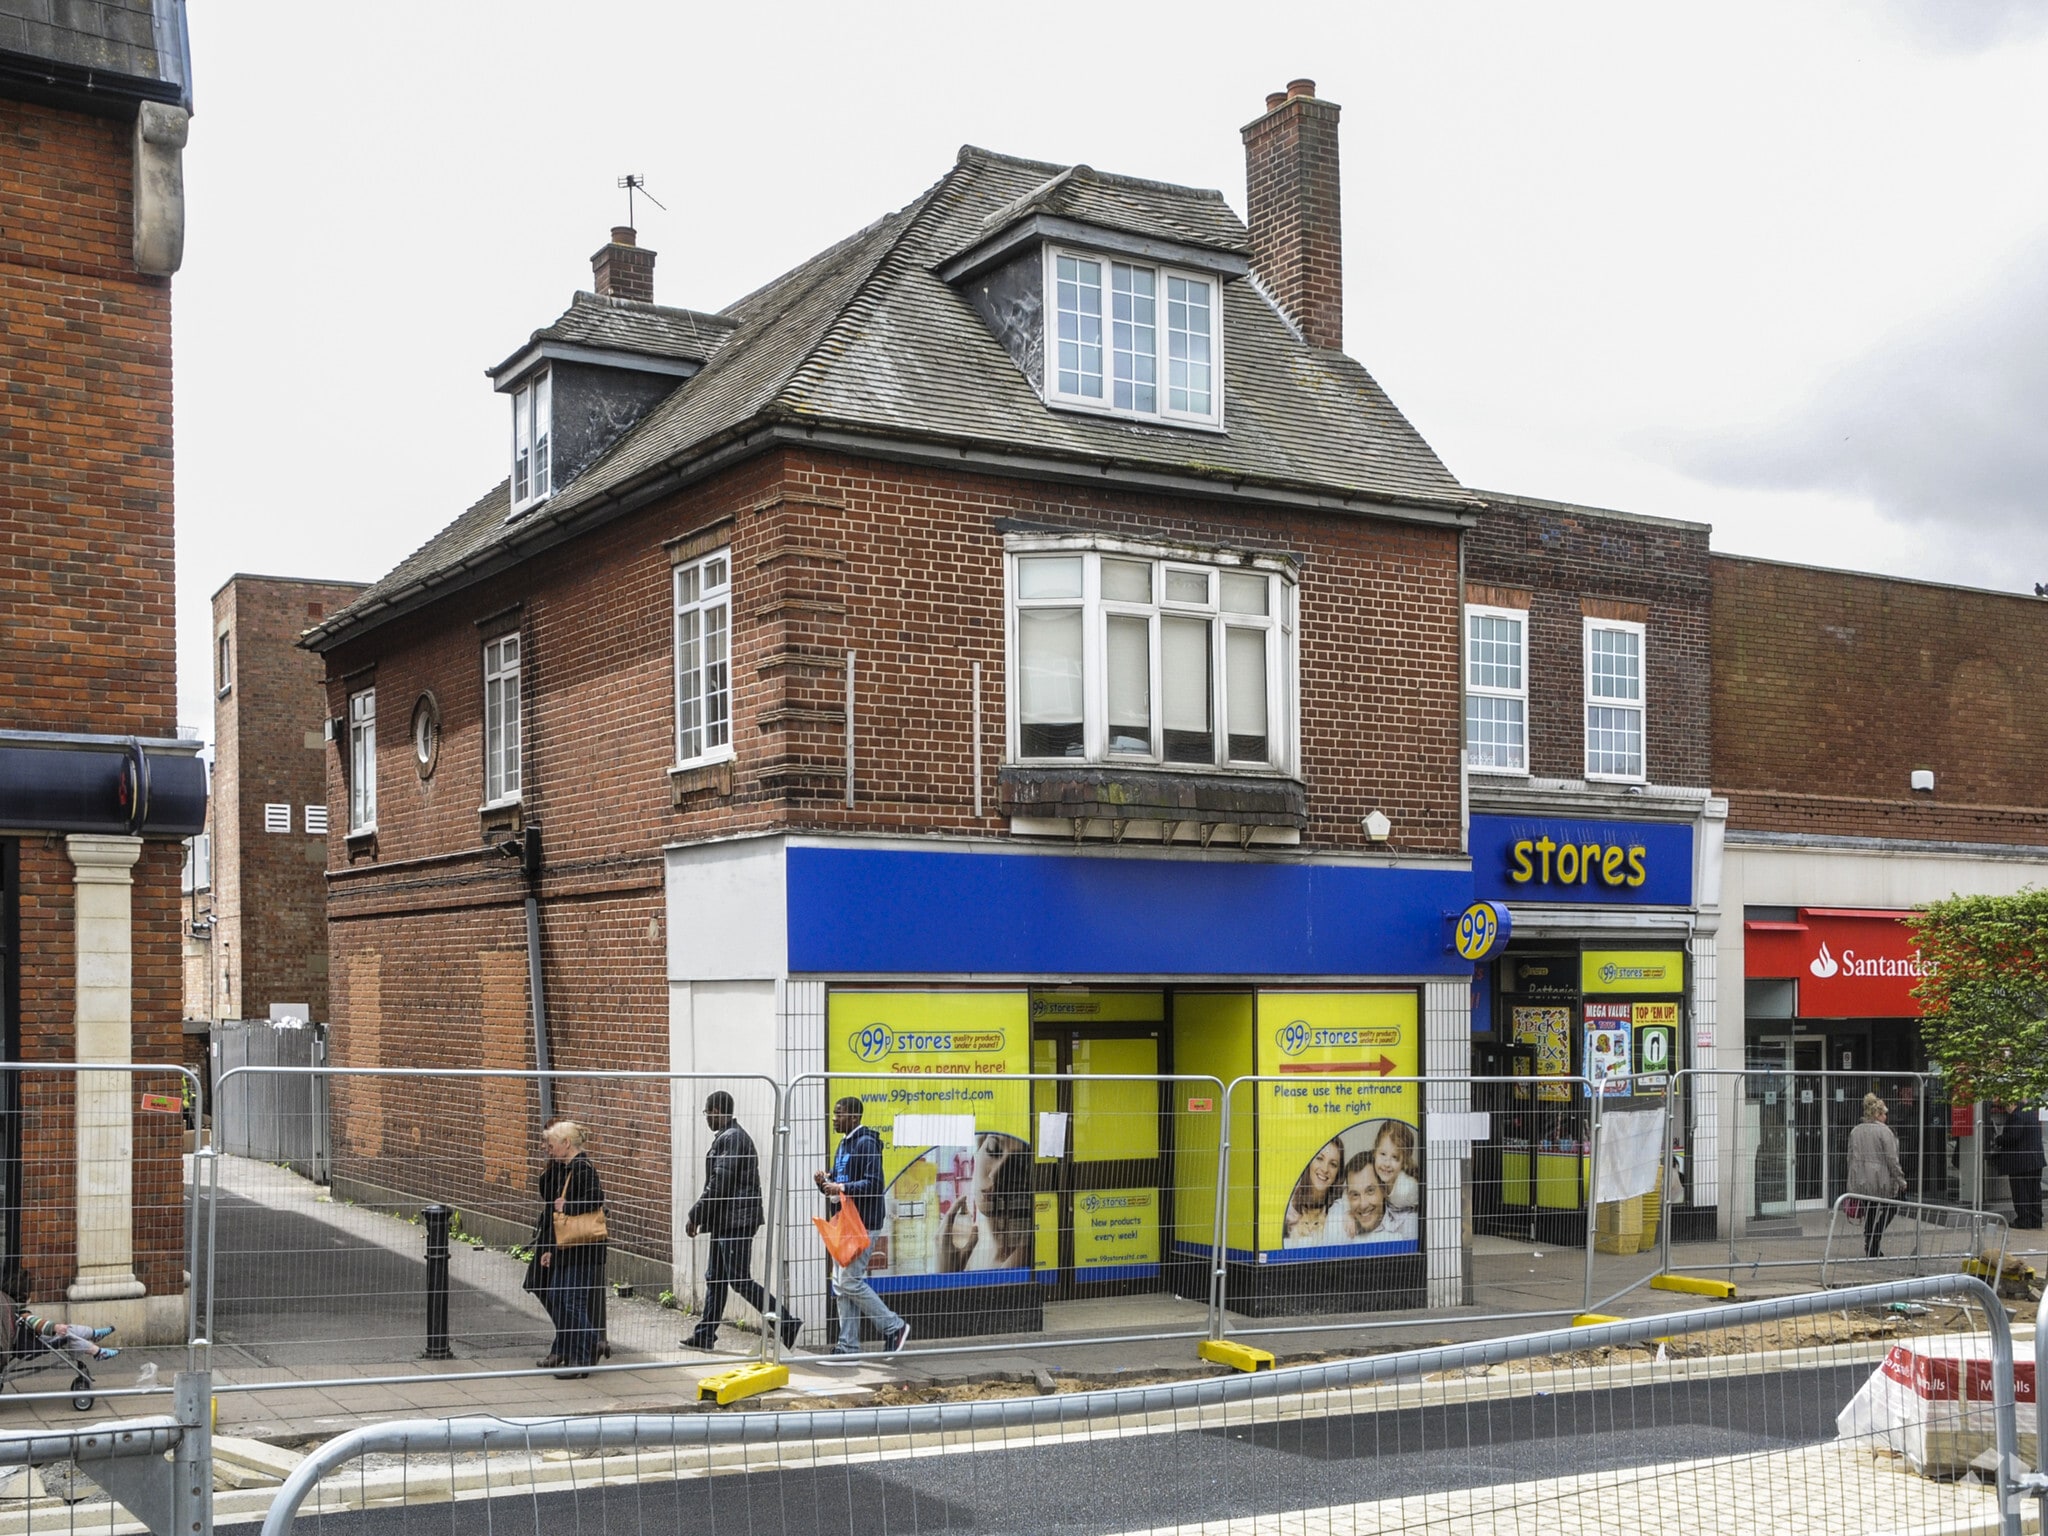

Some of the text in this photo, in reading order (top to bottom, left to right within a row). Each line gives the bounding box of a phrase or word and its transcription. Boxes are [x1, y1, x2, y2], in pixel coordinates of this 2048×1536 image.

[1511, 835, 1647, 887] stores
[1461, 908, 1495, 955] 99p
[1619, 968, 1643, 978] stores
[1050, 1002, 1076, 1013] stores
[1585, 1004, 1631, 1018] MEGA VALUE!
[1635, 1006, 1675, 1020] TOP 'EM UP!
[861, 1027, 952, 1058] 99p stores
[953, 1034, 1001, 1043] quality products
[1285, 1024, 1358, 1052] 99p stores
[891, 1062, 920, 1073] Save
[936, 1064, 971, 1074] penny
[974, 1060, 1006, 1073] here!
[861, 1088, 994, 1105] www.99pstoresltd.com
[1274, 1084, 1403, 1097] Please use the entrance
[1307, 1101, 1372, 1115] to the right
[1102, 1198, 1127, 1207] stores
[1091, 1217, 1141, 1228] New products
[1094, 1230, 1138, 1242] every week!
